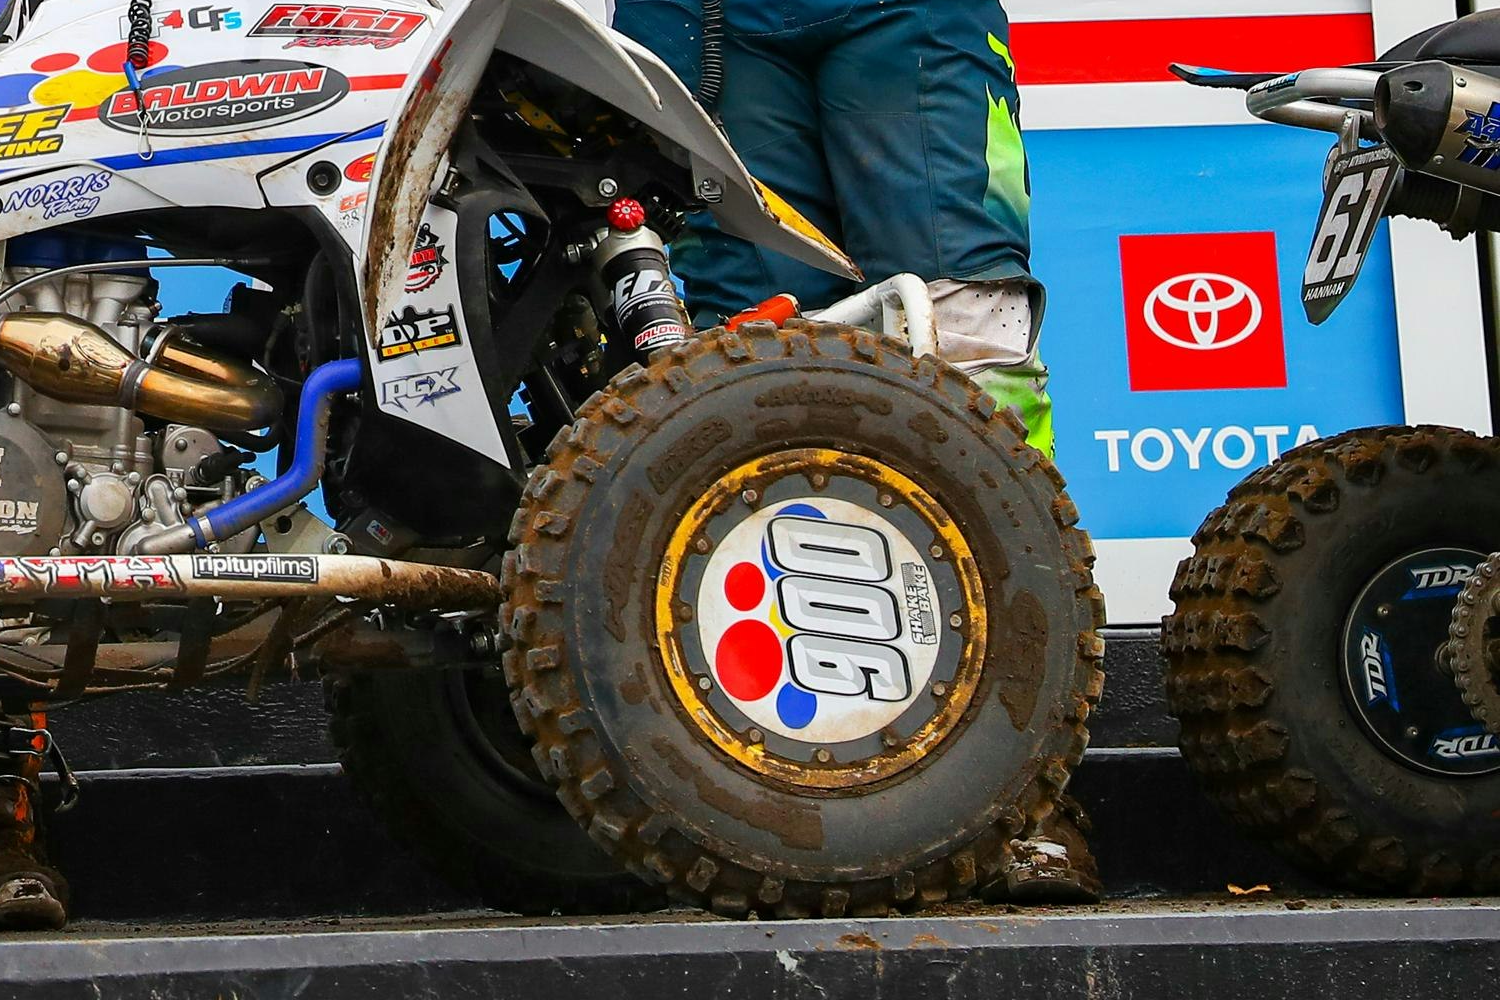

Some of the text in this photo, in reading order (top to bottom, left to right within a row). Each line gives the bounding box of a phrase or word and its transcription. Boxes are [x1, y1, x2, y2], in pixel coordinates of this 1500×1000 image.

[109, 68, 325, 115] BALDWIN
[147, 97, 295, 124] Motorsports
[3, 171, 112, 212] NORRIS
[44, 196, 100, 218] Racing
[1304, 166, 1390, 286] 61
[1304, 282, 1345, 301] HANNAH
[381, 314, 451, 347] DP
[386, 335, 455, 355] BRAKES
[916, 563, 931, 612] BAKE
[907, 585, 927, 645] SHAKE
